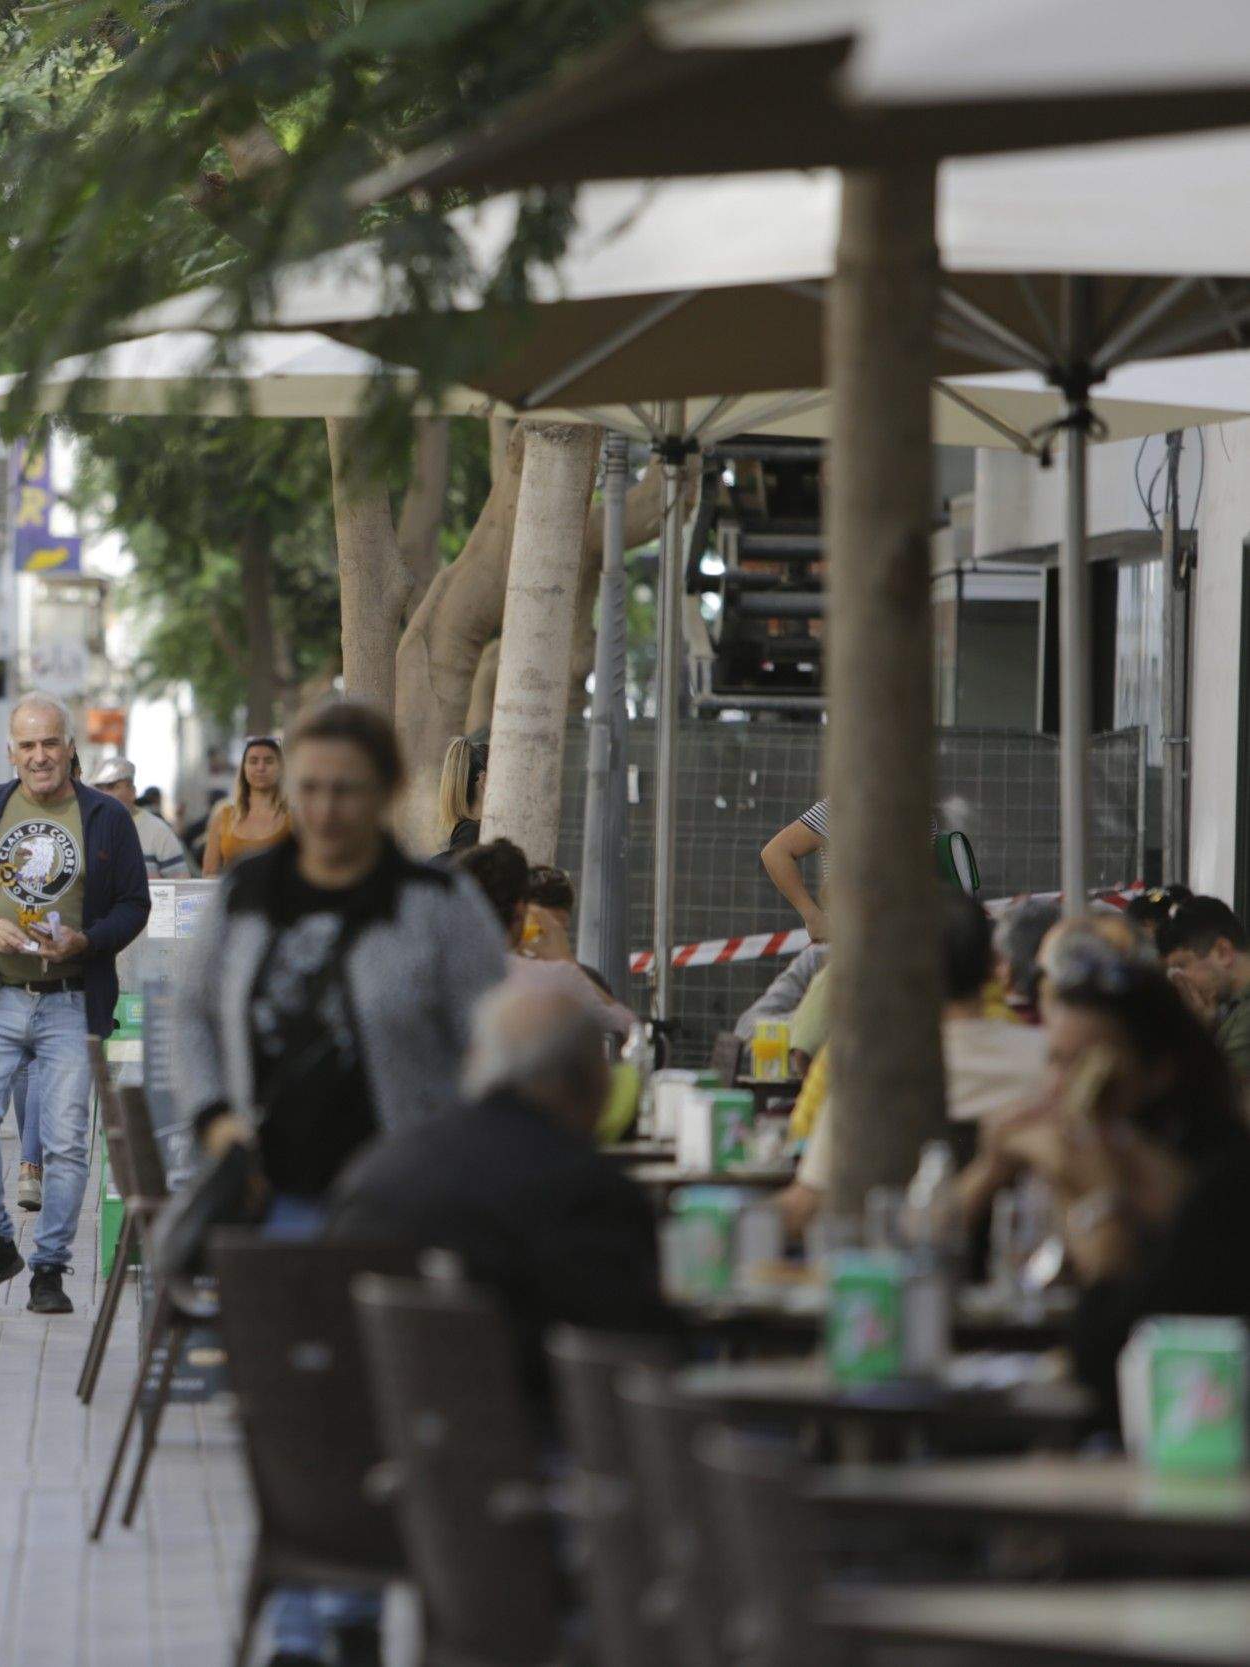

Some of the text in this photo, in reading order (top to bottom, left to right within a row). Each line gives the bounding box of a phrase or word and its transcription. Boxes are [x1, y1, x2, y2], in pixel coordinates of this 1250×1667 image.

[0, 824, 75, 874] CLAN OF COLORS
